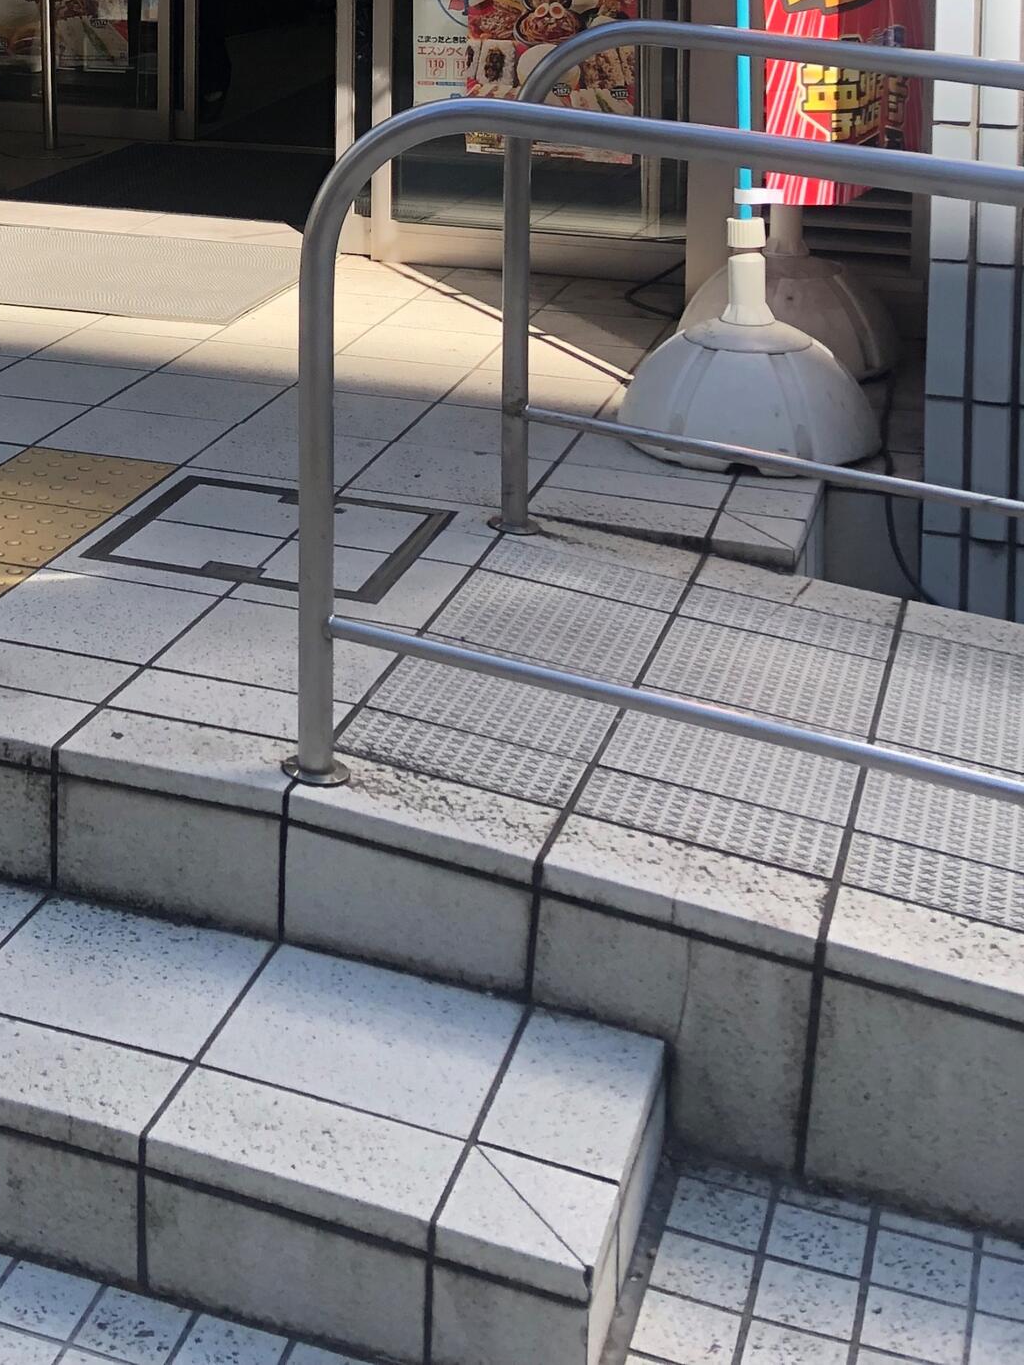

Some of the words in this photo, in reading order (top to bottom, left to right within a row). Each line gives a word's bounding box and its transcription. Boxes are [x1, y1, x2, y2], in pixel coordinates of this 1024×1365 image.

[417, 35, 467, 44] こまったときは
[428, 59, 445, 69] 110
